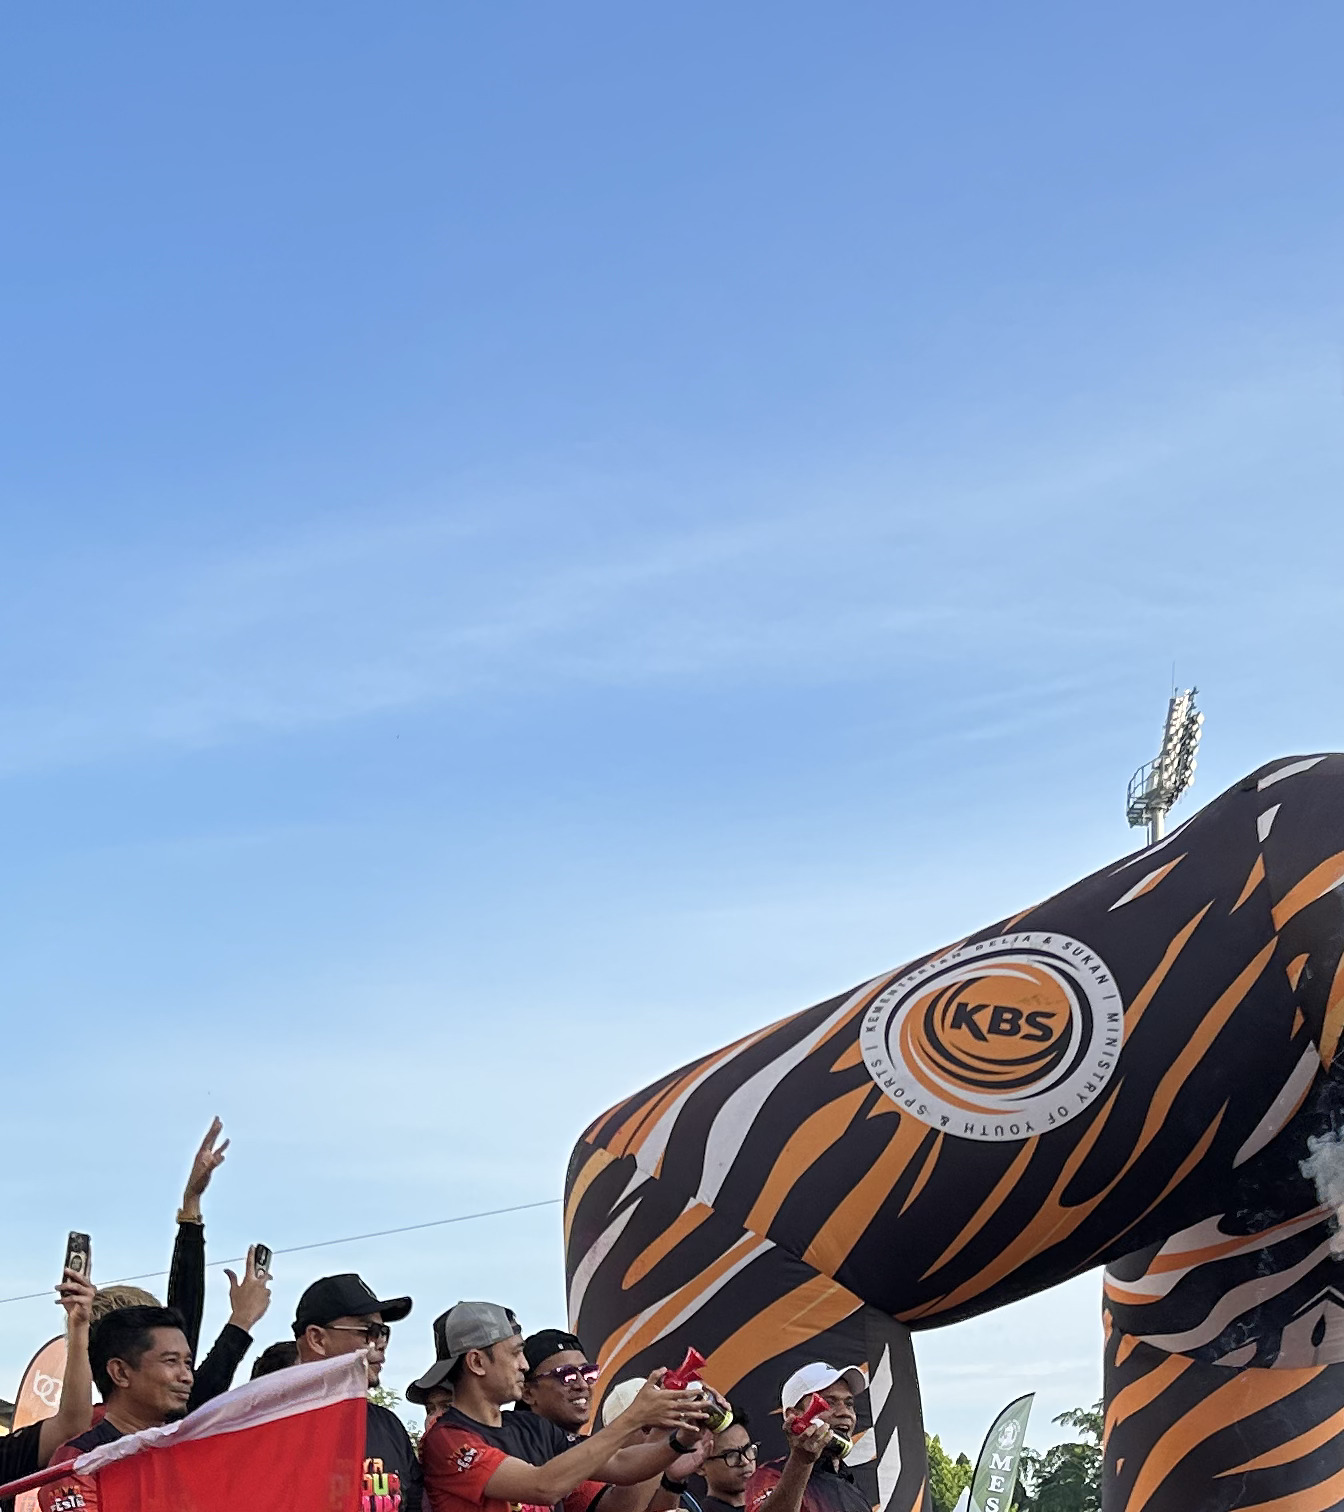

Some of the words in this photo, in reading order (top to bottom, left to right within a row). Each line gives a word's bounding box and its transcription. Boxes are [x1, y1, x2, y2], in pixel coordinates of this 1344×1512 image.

[1061, 941, 1110, 986] SUKAN
[950, 1002, 1059, 1042] KBS
[1075, 1011, 1120, 1104] MINISTRY
[870, 1057, 929, 1116] SPORTS
[963, 1121, 1034, 1137] YOUTH
[1047, 1105, 1069, 1125] OF
